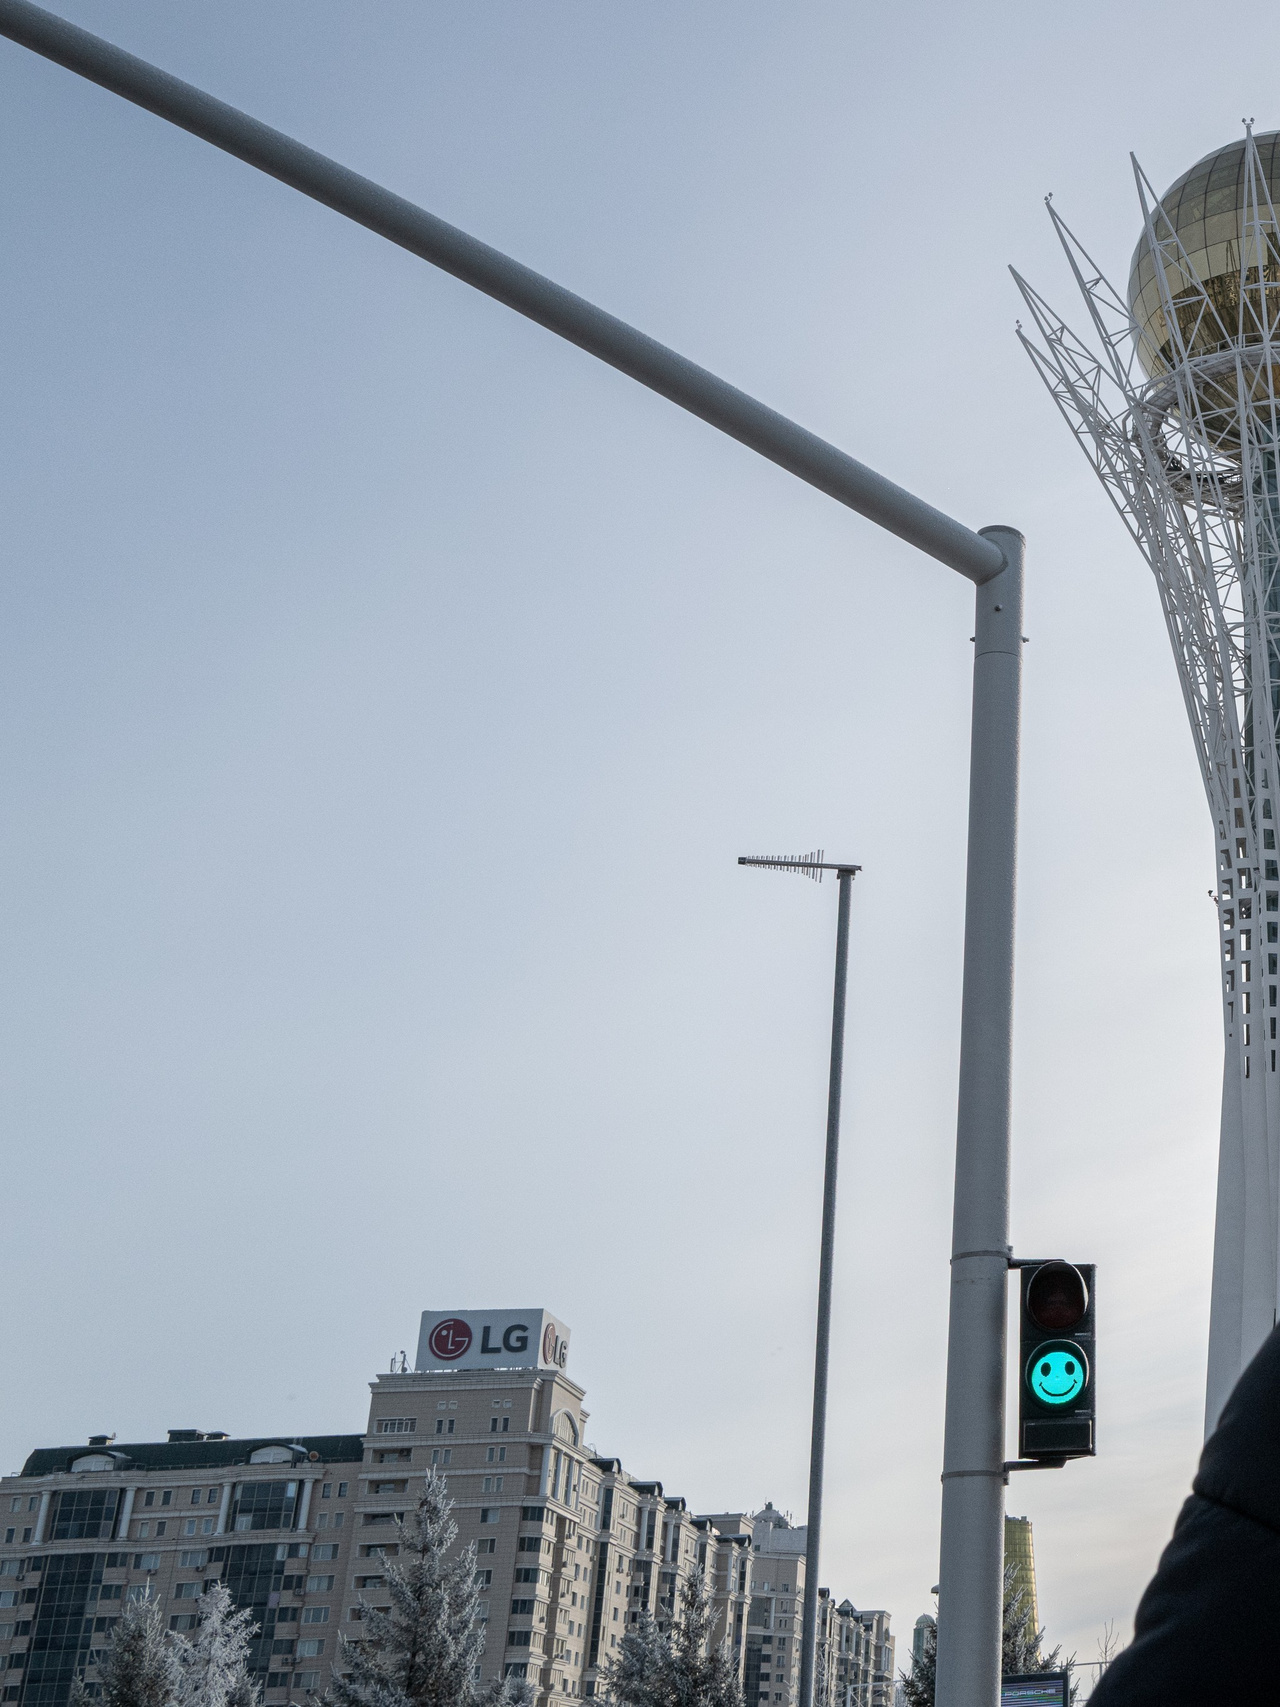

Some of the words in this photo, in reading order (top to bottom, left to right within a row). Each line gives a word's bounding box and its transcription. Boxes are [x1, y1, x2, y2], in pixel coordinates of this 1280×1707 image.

[480, 1323, 529, 1354] LG
[553, 1334, 568, 1369] LG
[1004, 1688, 1056, 1697] PORSCHE
